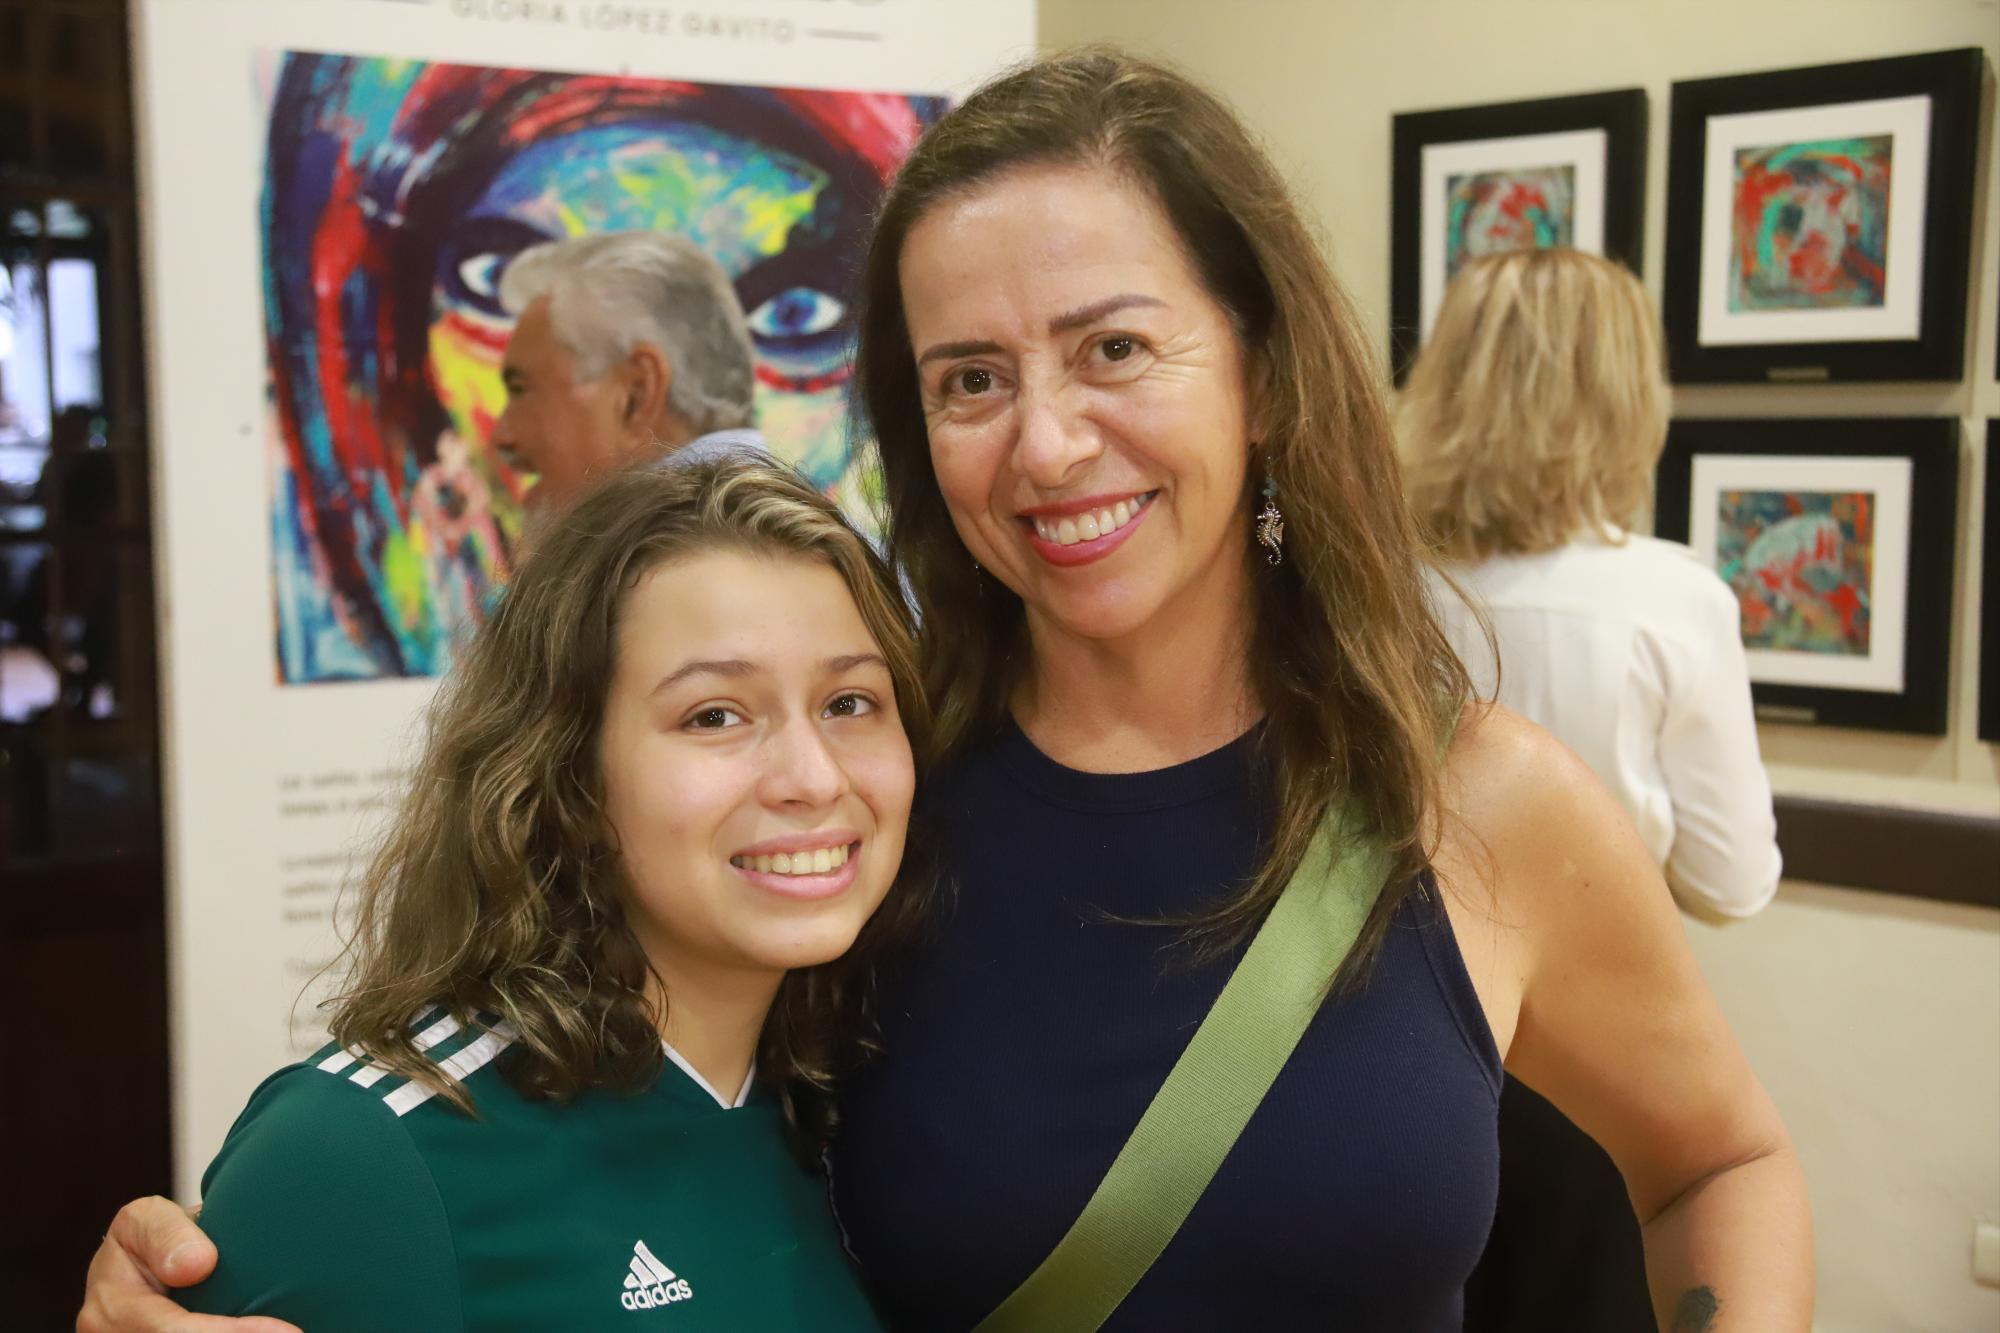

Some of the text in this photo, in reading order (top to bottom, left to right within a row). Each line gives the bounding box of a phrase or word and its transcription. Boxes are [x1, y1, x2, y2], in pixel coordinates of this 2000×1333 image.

[451, 0, 796, 44] GLORIA LÓPEZ GAVITO
[621, 1279, 693, 1310] adidas
